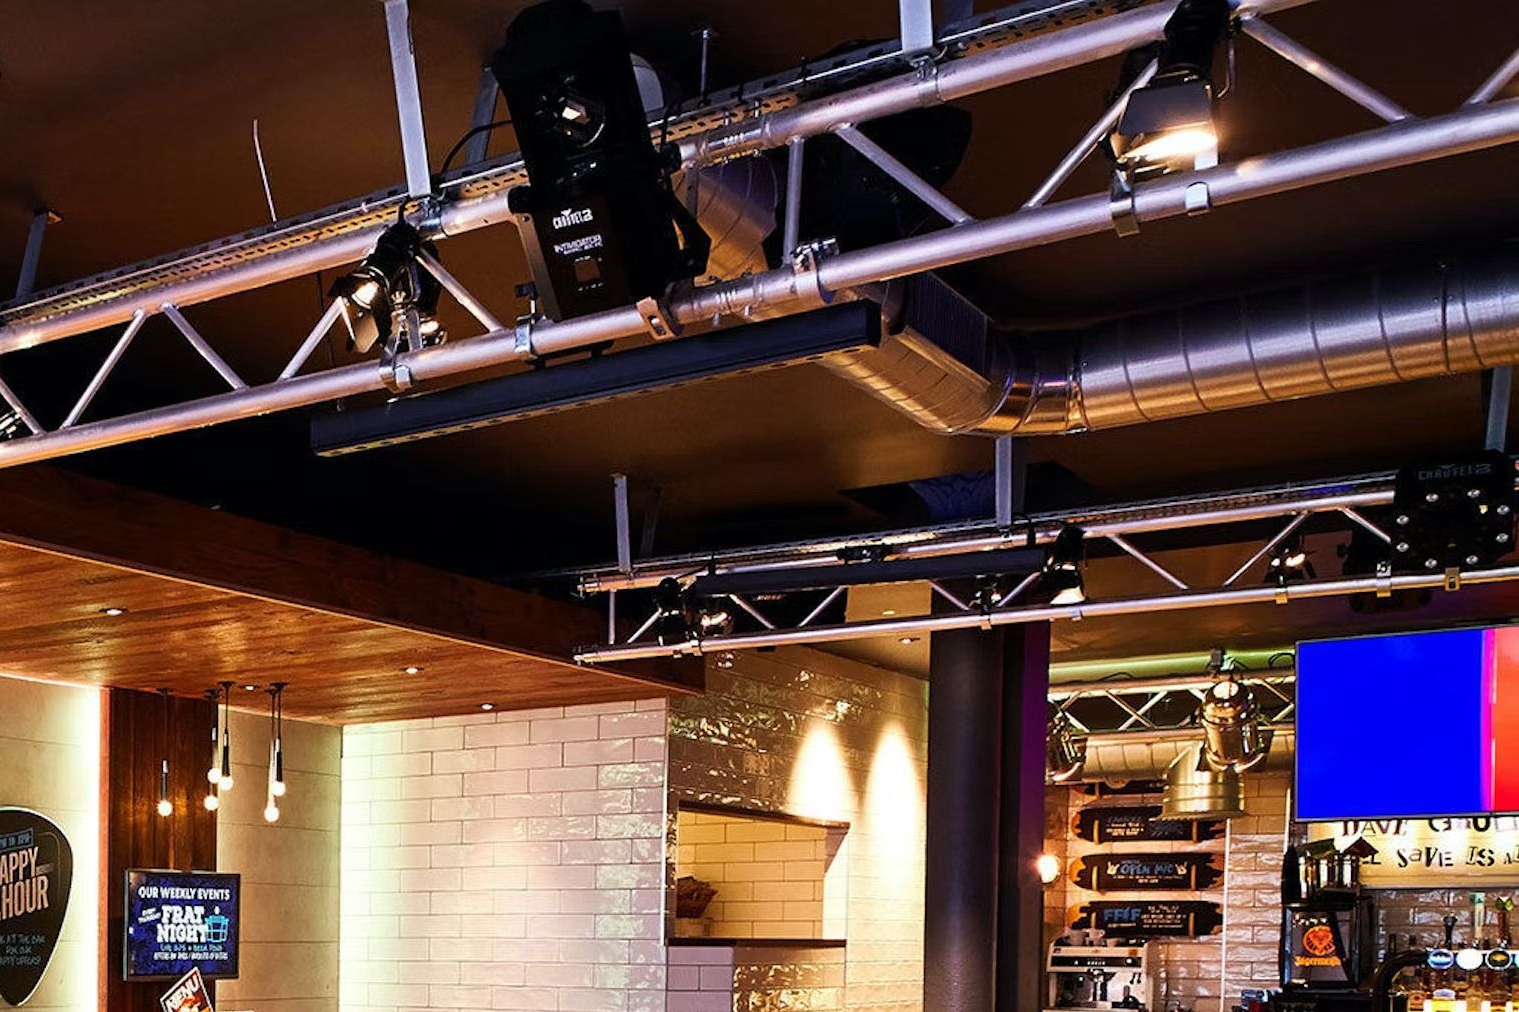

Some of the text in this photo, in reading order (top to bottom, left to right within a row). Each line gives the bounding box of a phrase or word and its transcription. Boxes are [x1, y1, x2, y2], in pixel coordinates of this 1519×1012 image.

[2, 875, 50, 920] HOUR
[138, 886, 230, 901] OUR WEEKLY EVENTS
[161, 905, 206, 924] FRAT
[156, 923, 209, 943] NIGHT
